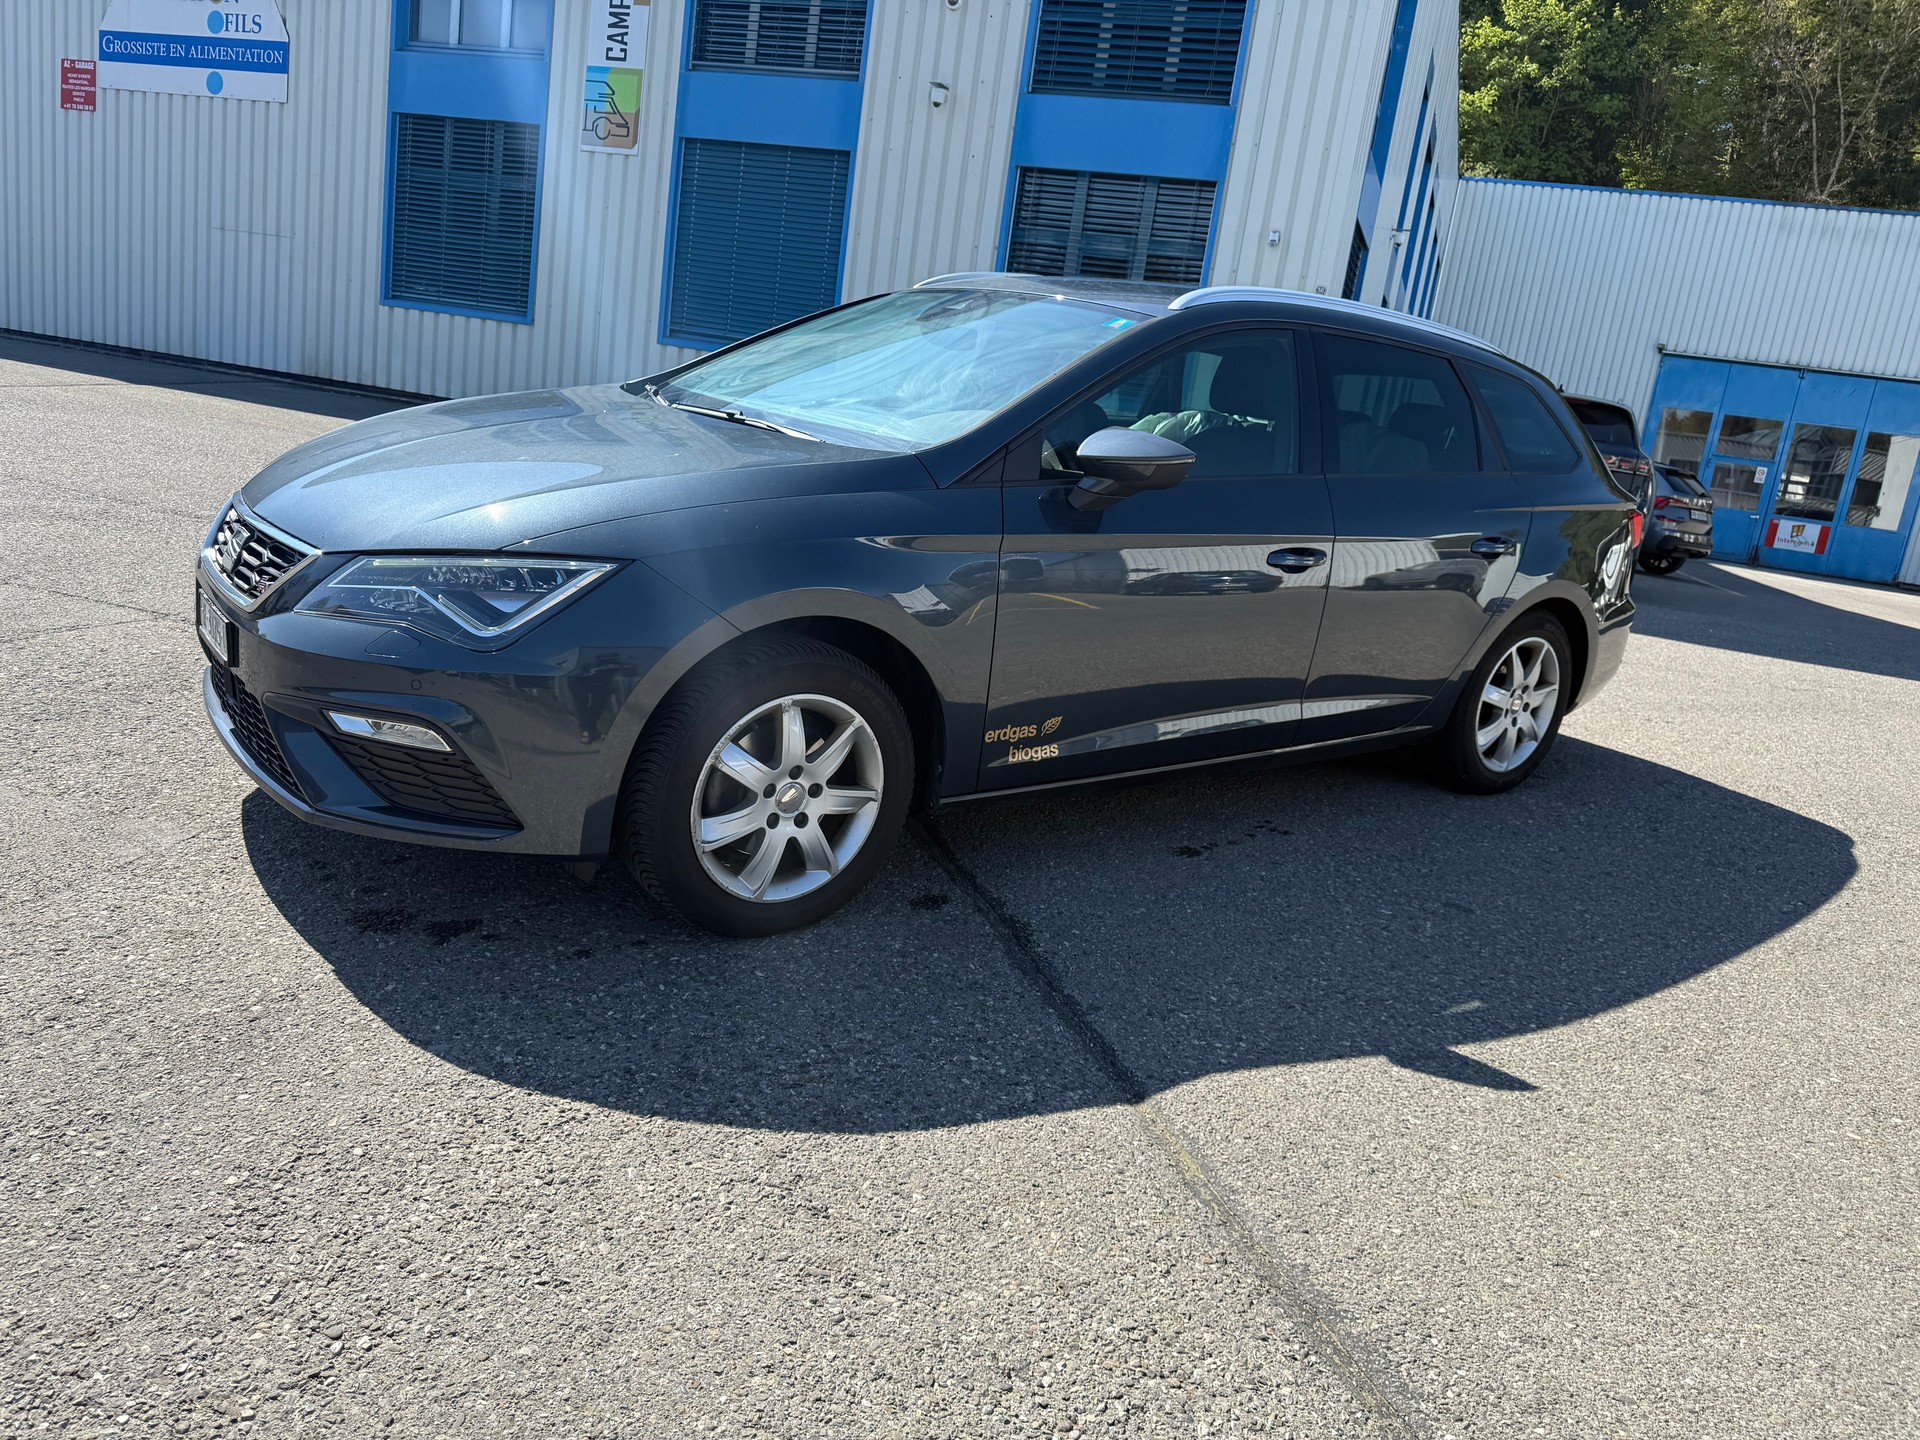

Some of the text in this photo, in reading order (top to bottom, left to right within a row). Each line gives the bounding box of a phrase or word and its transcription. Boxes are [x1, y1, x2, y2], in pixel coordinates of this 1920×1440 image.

[224, 13, 262, 34] FILS
[102, 36, 284, 64] GROSSISTE EN ALIMENTATION
[64, 60, 71, 68] AZ
[75, 61, 95, 70] GARAGE
[985, 724, 1037, 743] erdgas
[1008, 744, 1059, 762] biogas
